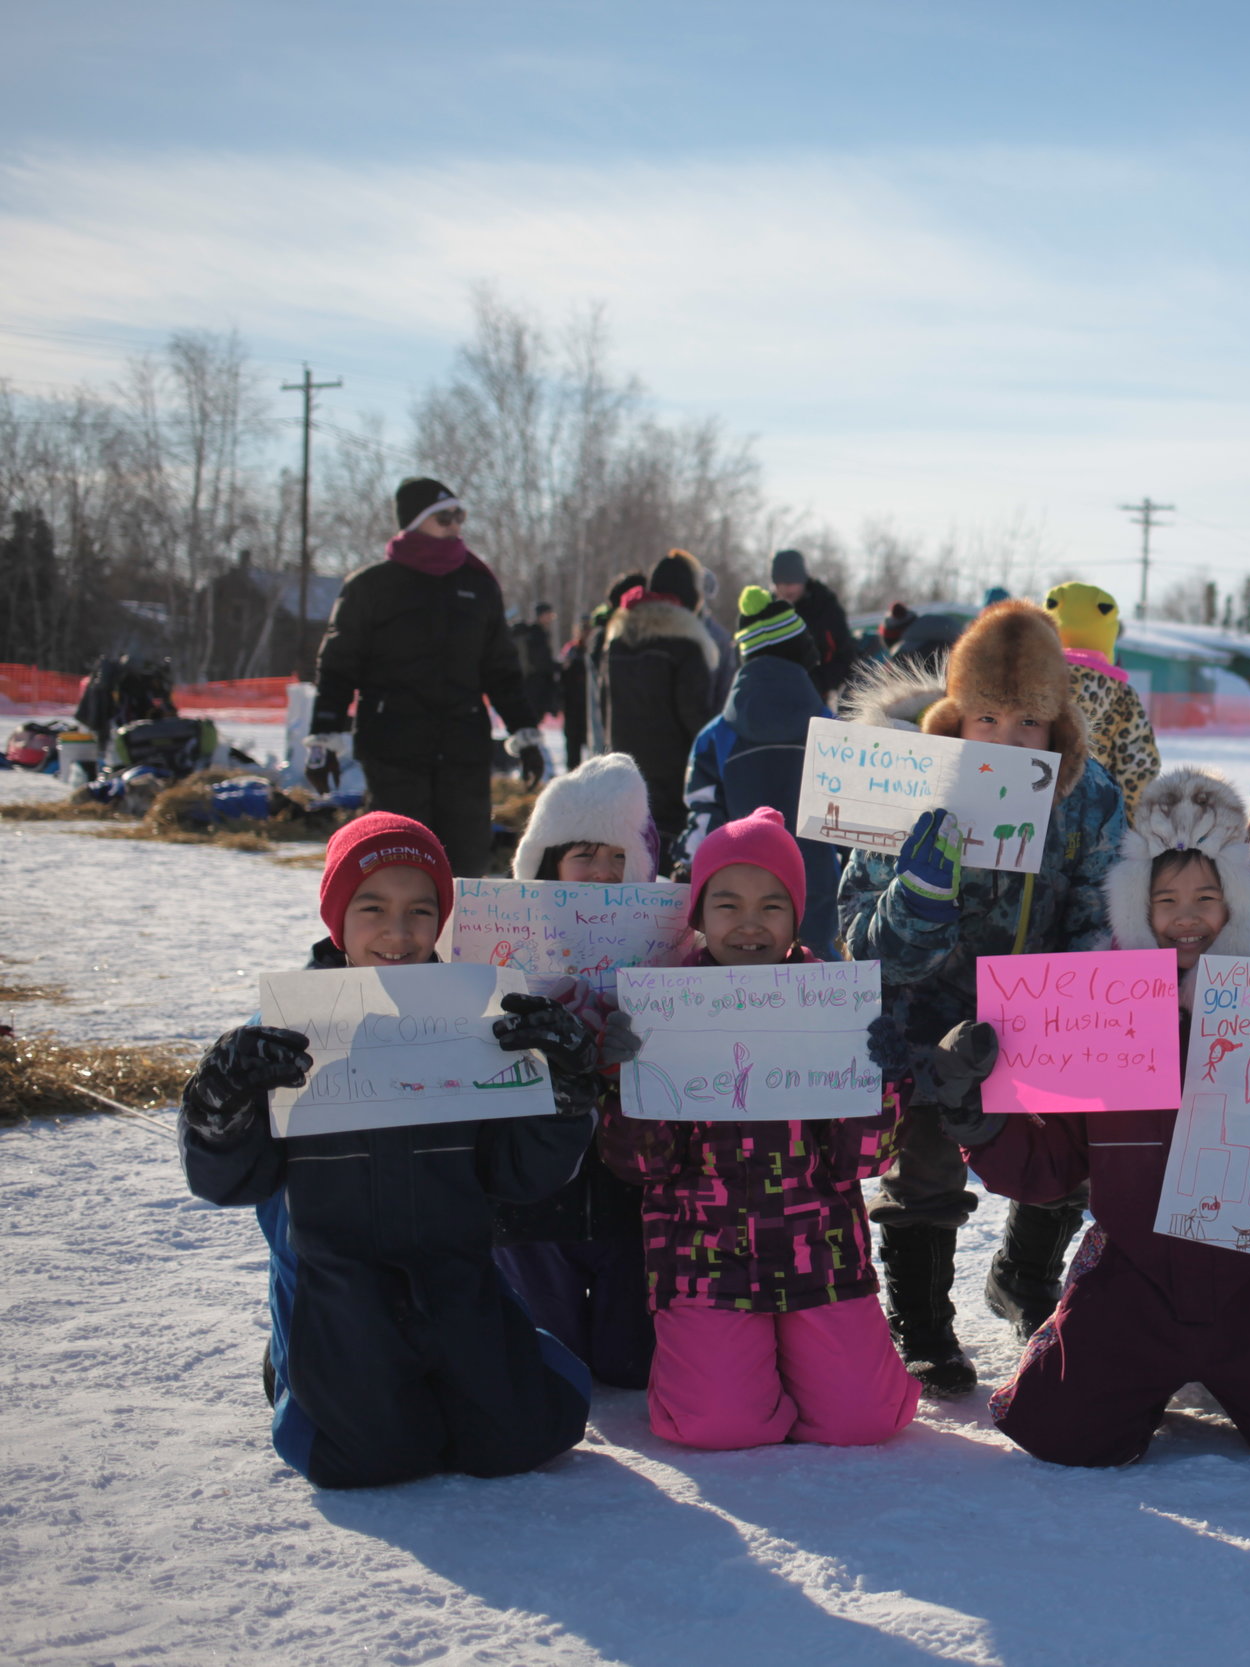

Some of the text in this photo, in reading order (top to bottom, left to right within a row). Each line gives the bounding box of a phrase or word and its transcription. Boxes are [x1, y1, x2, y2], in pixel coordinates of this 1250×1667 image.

[380, 846, 436, 864] DONLIN
[459, 879, 501, 898] Way
[518, 884, 540, 899] to
[603, 887, 684, 910] Welcome
[459, 903, 478, 917] to
[632, 910, 651, 921] on
[544, 926, 567, 941] We
[725, 968, 752, 986] to
[773, 962, 860, 989] Huslia!
[987, 962, 1175, 1005] Welcome
[678, 986, 705, 1007] to
[1203, 986, 1239, 1015] go!
[266, 979, 471, 1050] Welcome
[993, 1002, 1137, 1040] to Huslia!
[1001, 1043, 1156, 1075] Way to go!
[765, 1067, 801, 1090] on
